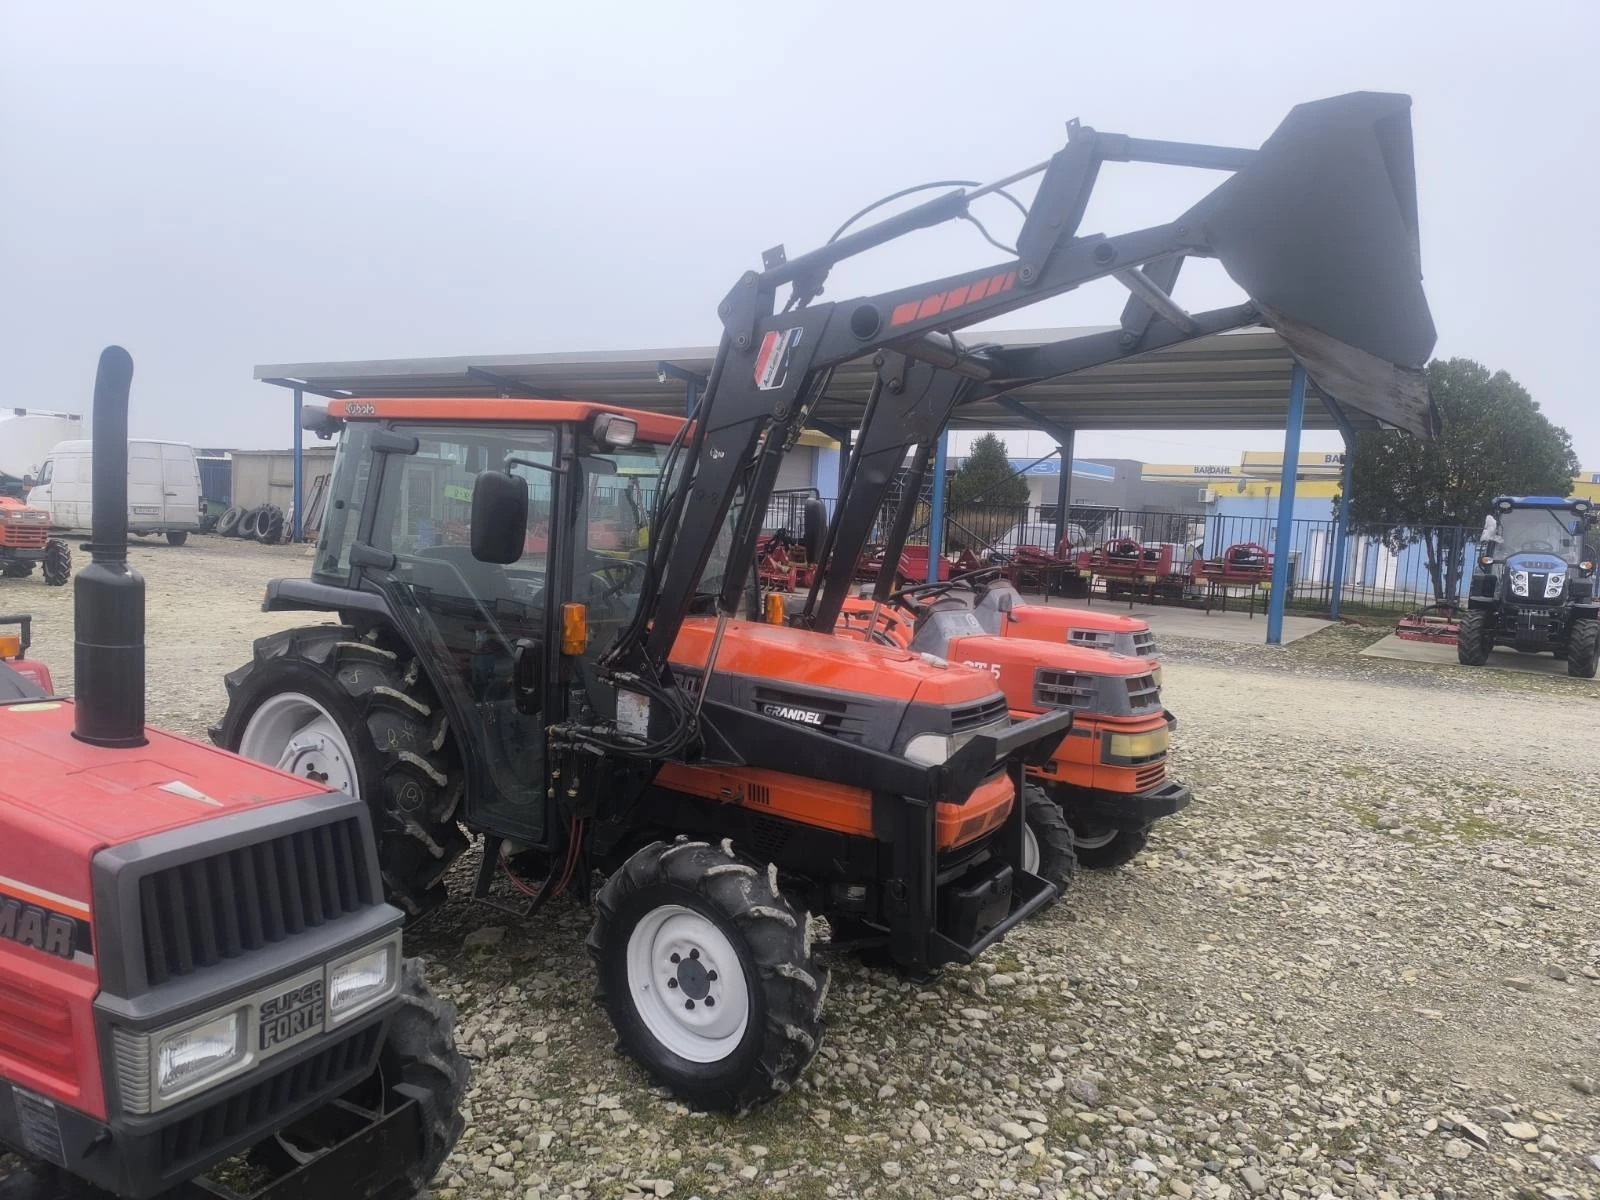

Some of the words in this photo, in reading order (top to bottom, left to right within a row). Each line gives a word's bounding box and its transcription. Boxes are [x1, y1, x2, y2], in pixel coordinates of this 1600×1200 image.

[345, 402, 375, 414] Kubota
[1193, 465, 1232, 475] BARDAHL
[763, 704, 823, 725] GRANDEL
[260, 979, 324, 1020] SUPER
[260, 1000, 325, 1050] FORTE
